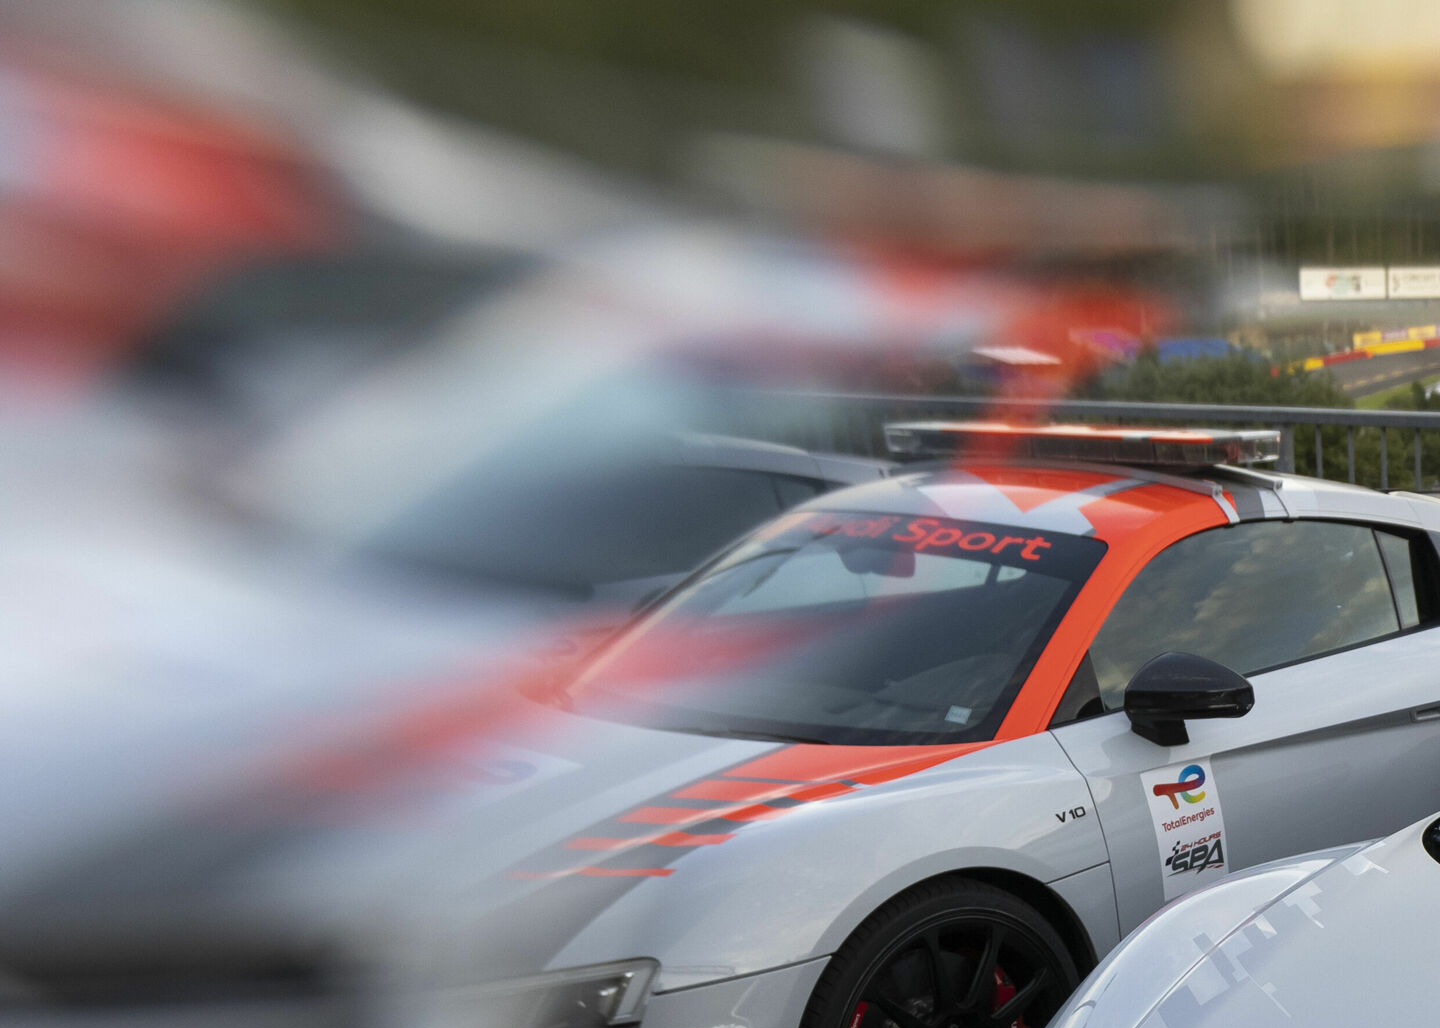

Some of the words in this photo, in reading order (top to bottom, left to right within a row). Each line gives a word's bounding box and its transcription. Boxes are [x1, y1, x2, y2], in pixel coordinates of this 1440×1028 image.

[893, 519, 1052, 560] Sport
[1161, 807, 1215, 832] TotalEnergies
[1193, 830, 1222, 847] HOURS
[1170, 838, 1224, 875] SPA
